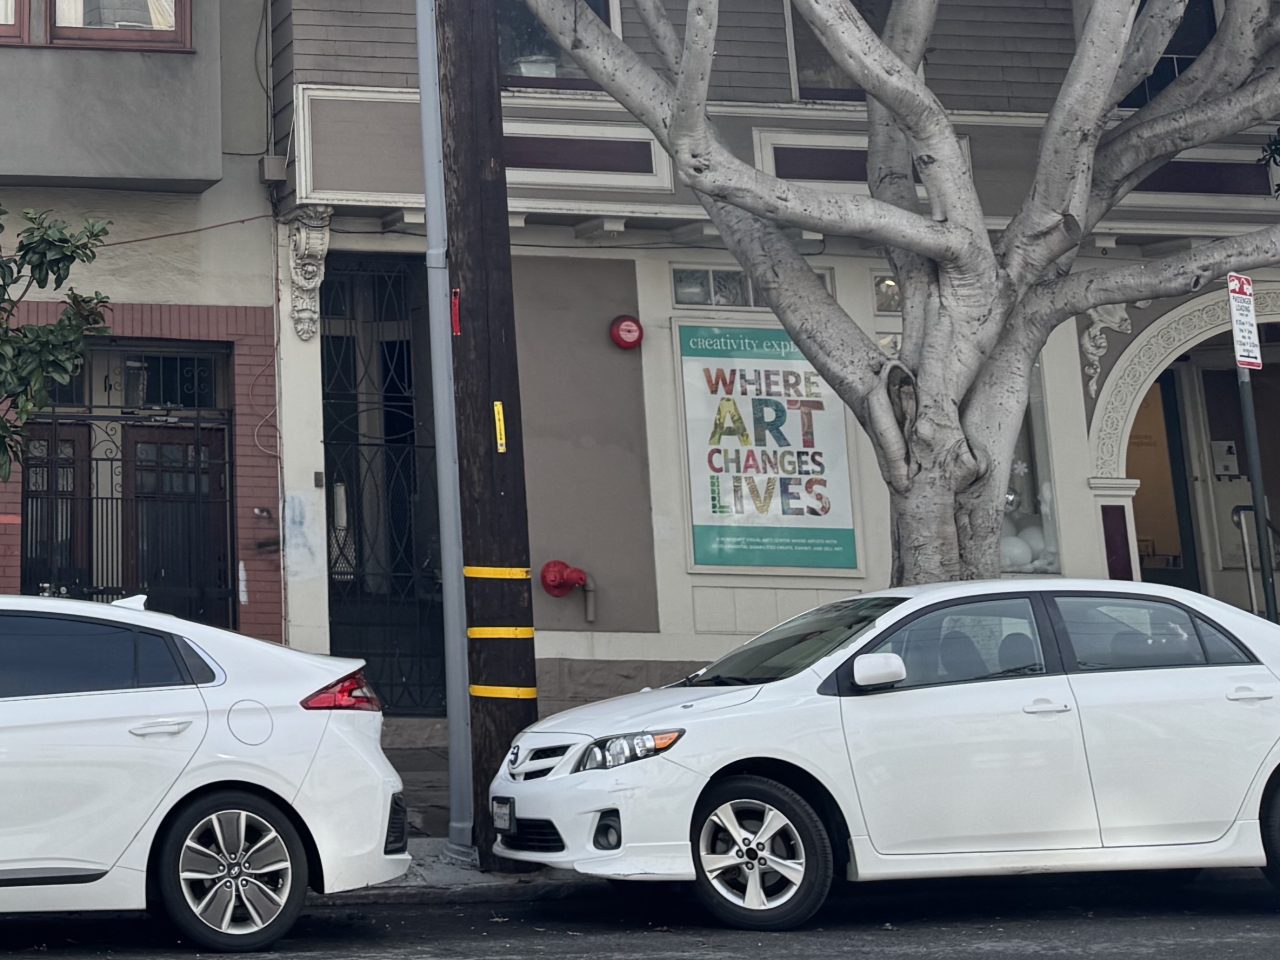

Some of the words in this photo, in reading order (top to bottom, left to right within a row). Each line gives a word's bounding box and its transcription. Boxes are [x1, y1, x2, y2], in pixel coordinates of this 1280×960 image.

[703, 368, 822, 398] WHERE
[708, 397, 825, 448] ART
[707, 448, 825, 475] CHANGES
[709, 475, 831, 516] LIVES
